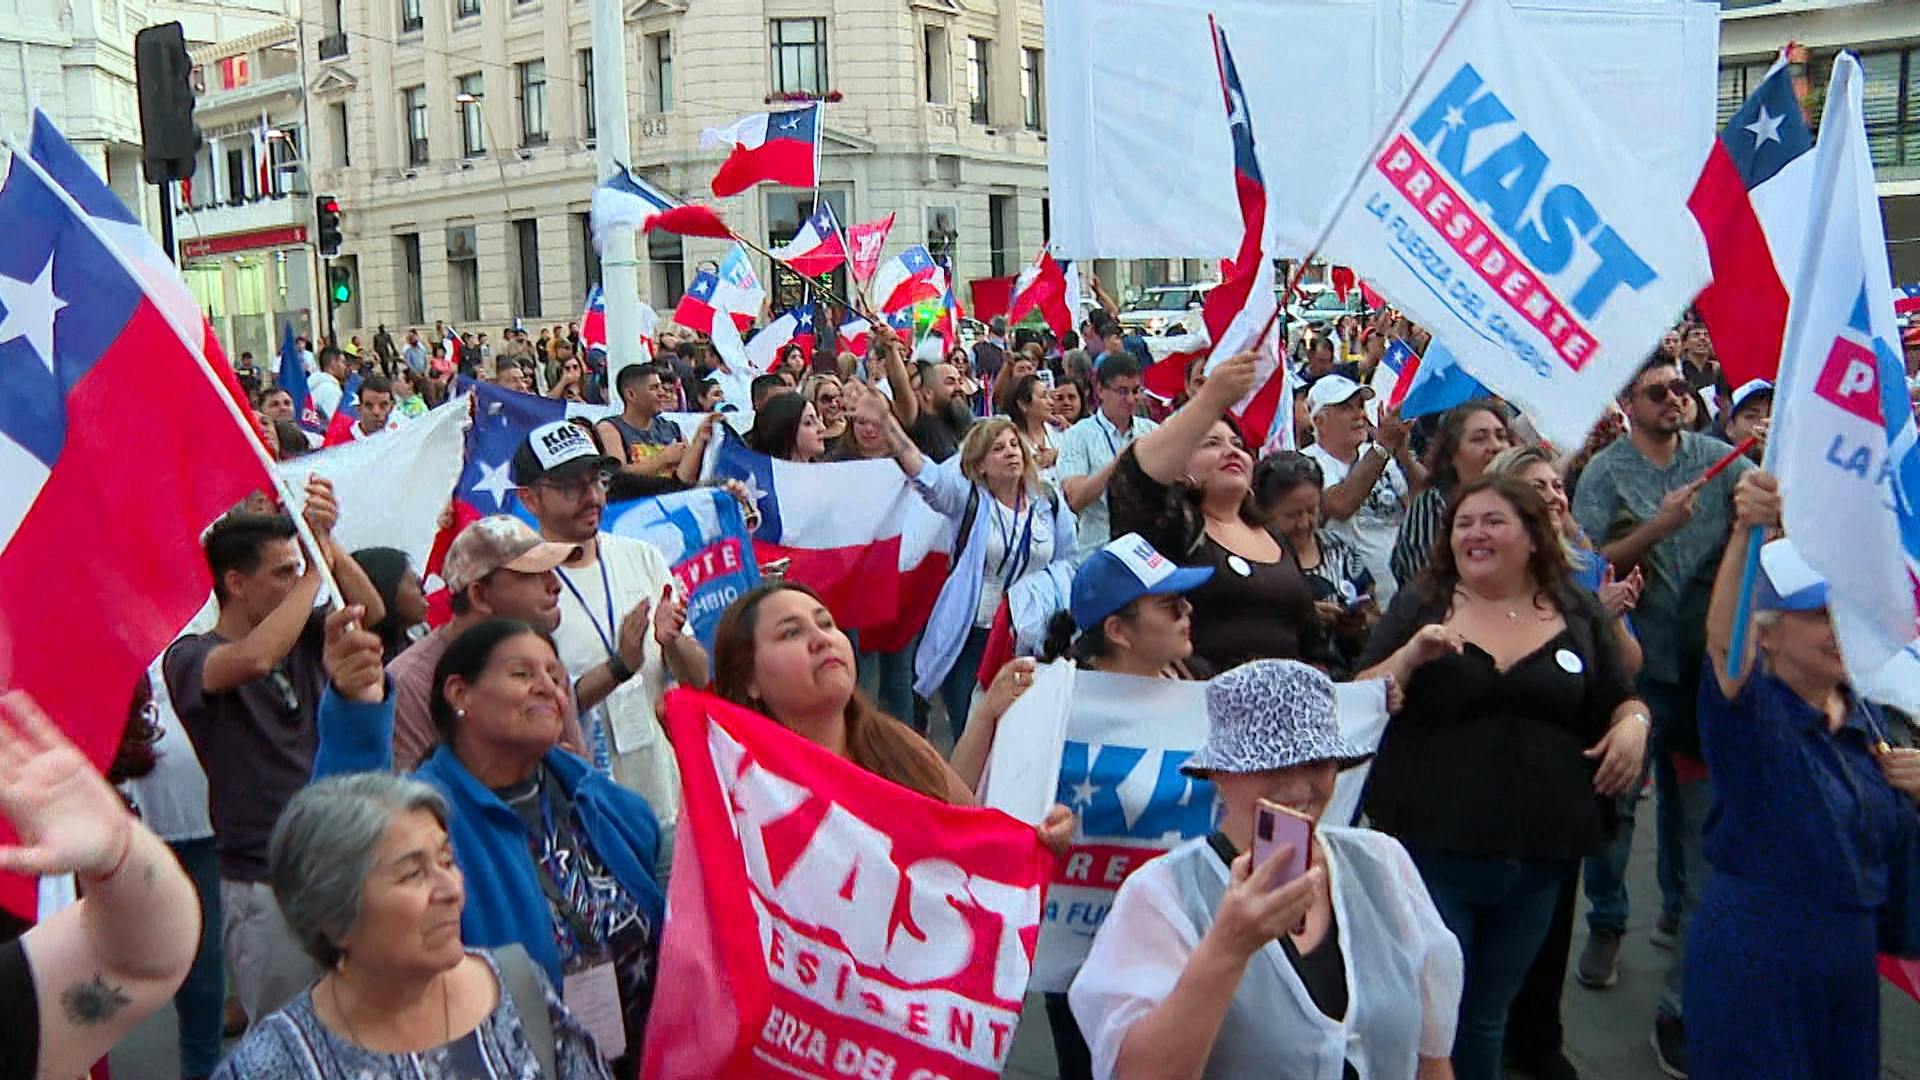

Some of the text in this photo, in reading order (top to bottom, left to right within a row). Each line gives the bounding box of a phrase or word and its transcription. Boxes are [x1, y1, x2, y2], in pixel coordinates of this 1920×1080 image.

[1385, 146, 1590, 361] PRESIDENTE
[1409, 62, 1658, 321] KAST
[1826, 434, 1872, 478] LA
[707, 716, 1040, 1000] KAST
[1066, 902, 1112, 926] FU
